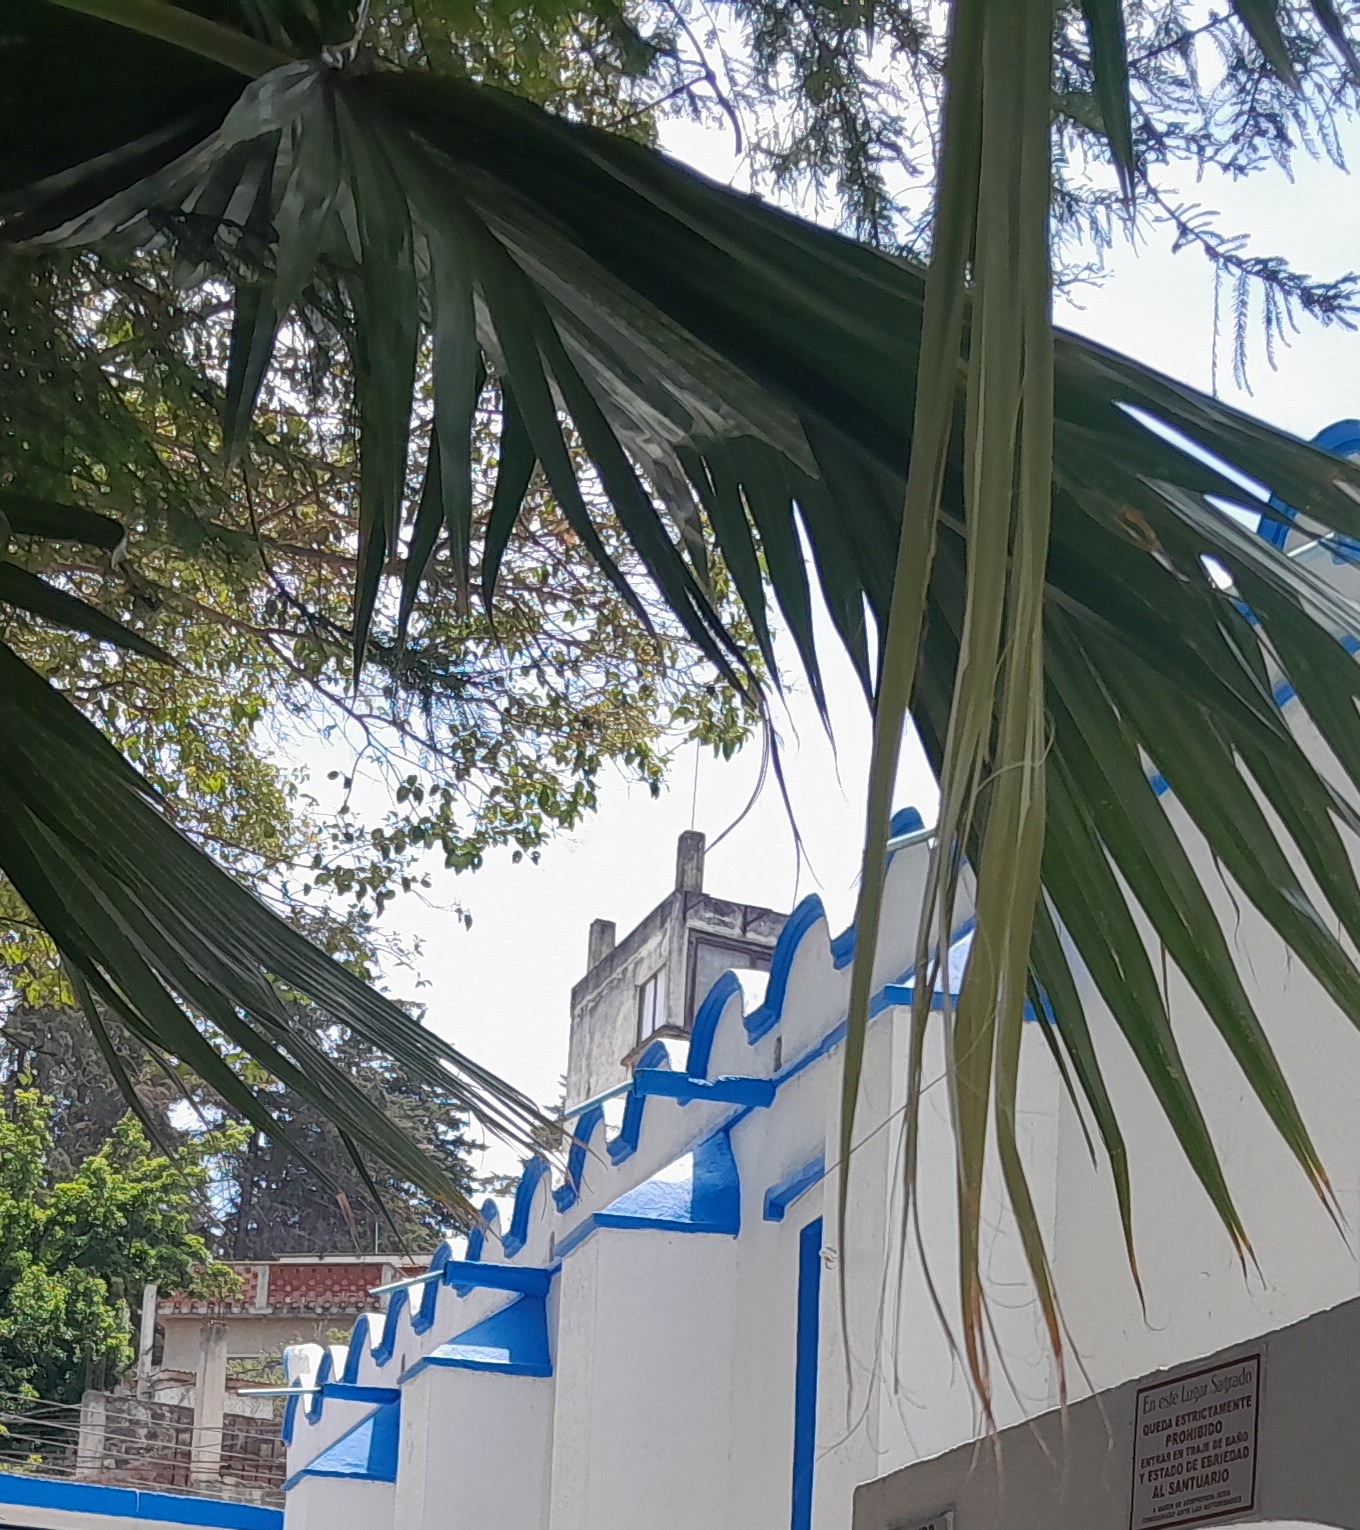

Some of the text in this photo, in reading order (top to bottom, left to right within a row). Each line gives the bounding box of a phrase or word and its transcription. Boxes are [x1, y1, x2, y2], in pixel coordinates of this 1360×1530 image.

[1142, 1395, 1156, 1415] En
[1158, 1390, 1179, 1410] este
[1142, 1394, 1253, 1436] QUEDA ESTRICTAMENTE
[1165, 1419, 1223, 1448] PROHIBIDO
[1139, 1445, 1250, 1485] Y ESTADO DE EBRIEDAD
[1173, 1448, 1184, 1461] EN
[1152, 1484, 1165, 1499] AL
[1168, 1468, 1229, 1495] SANTUARIO
